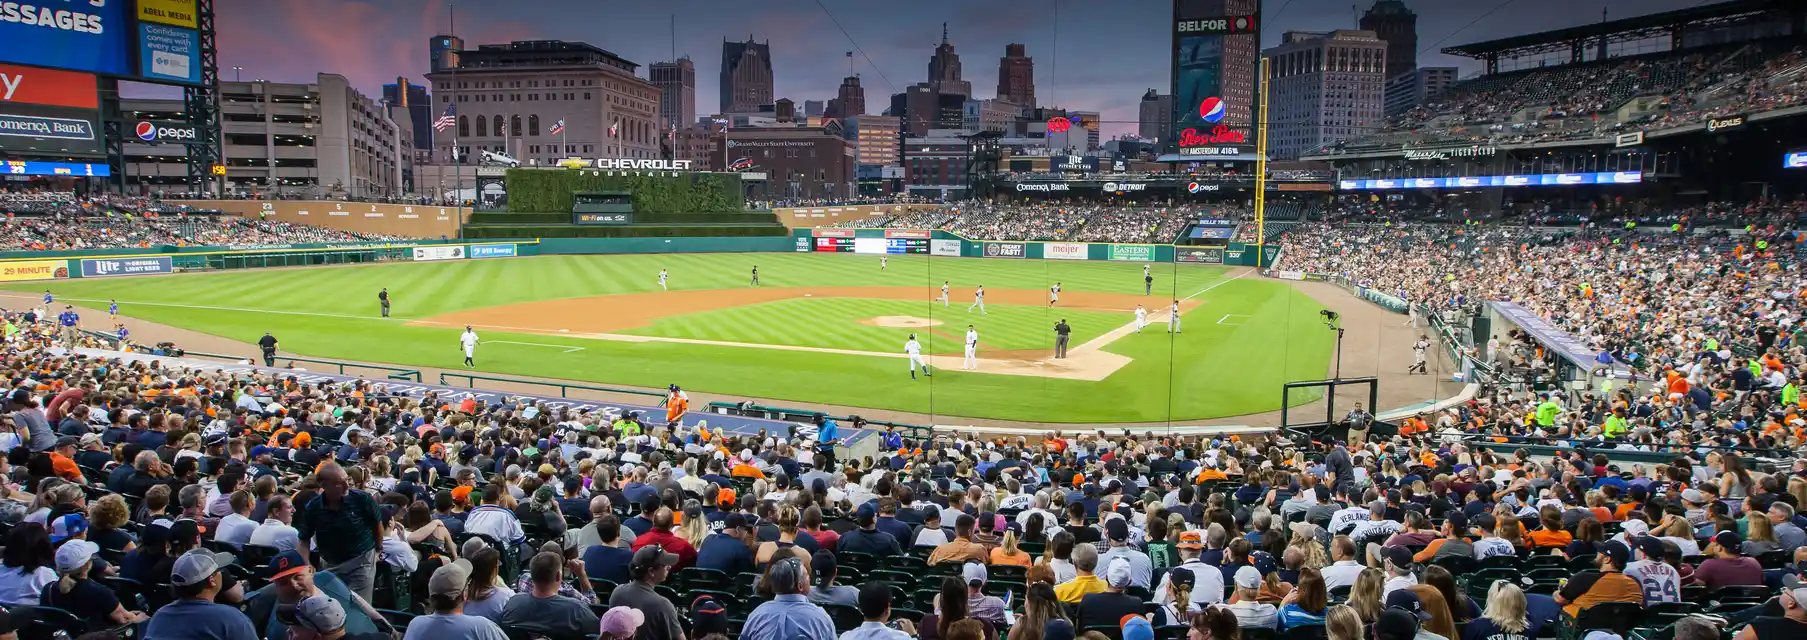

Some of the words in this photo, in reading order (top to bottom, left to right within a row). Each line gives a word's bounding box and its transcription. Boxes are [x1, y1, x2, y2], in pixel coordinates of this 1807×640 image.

[168, 11, 192, 21] MEDIA
[1178, 20, 1227, 32] BELFOR
[147, 43, 169, 52] every
[175, 38, 191, 47] with
[1716, 117, 1742, 128] LEXUS
[53, 122, 86, 134] Bank
[158, 127, 196, 140] pepsi
[597, 158, 693, 170] CHEVROLET
[1068, 155, 1083, 165] Lite
[580, 170, 678, 178] FOUNTAIN
[1050, 183, 1070, 191] Bank
[1118, 183, 1146, 191] DETROIT
[1199, 184, 1219, 192] pepsi
[1053, 243, 1079, 254] meijer
[1113, 244, 1150, 254] EASTERN
[4, 267, 15, 275] 29
[17, 266, 51, 274] MINUTE
[95, 260, 120, 274] Lite
[1340, 512, 1371, 523] VERLANDE
[1497, 545, 1513, 555] ROC
[1643, 578, 1680, 604] 24
